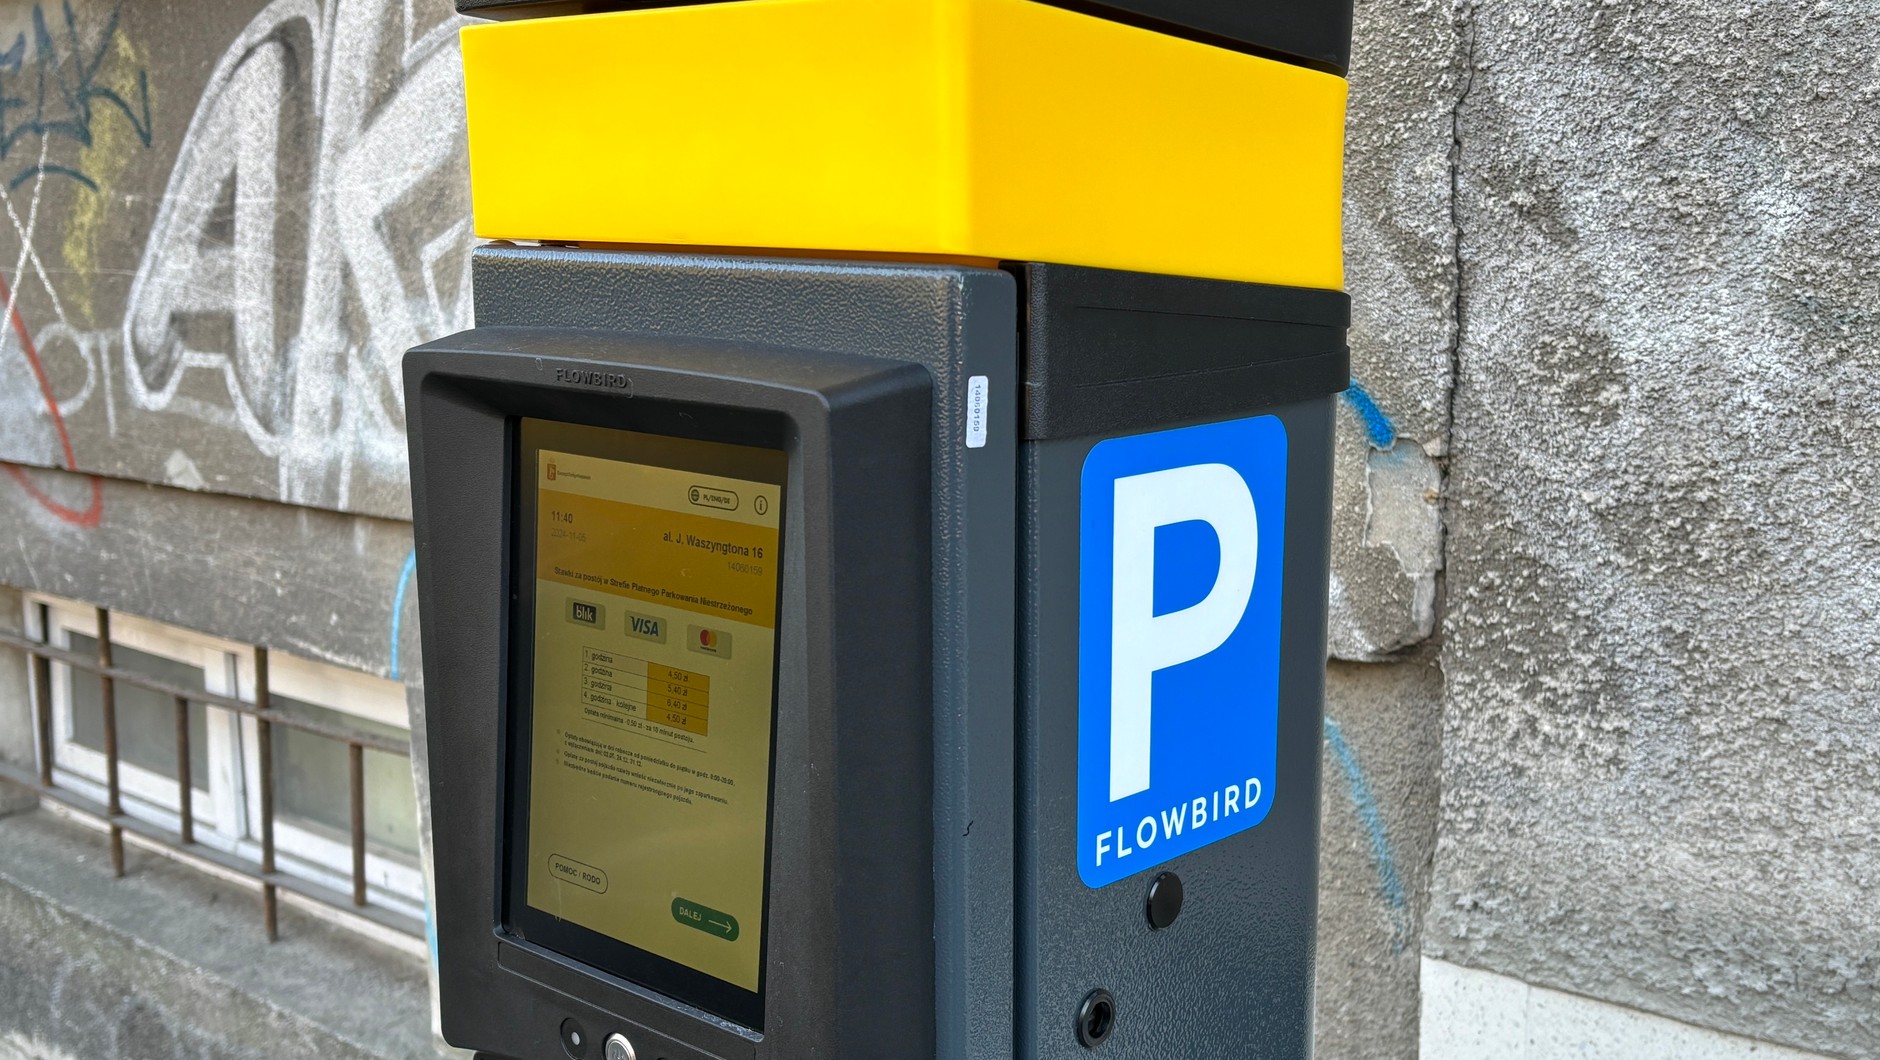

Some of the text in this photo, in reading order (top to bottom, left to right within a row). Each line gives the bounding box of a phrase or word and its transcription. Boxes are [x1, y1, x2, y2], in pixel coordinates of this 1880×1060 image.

[556, 368, 628, 389] FLOWBIRD
[551, 511, 573, 524] 11:40
[663, 531, 764, 559] al. J. Waszyngtona 16
[554, 566, 574, 577] Stawki
[574, 571, 582, 580] za
[603, 577, 608, 585] w
[661, 588, 699, 604] Parkowania
[699, 596, 753, 617] Niestrzeżonego
[575, 604, 593, 622] blik
[629, 615, 659, 637] VISA
[1110, 462, 1258, 802] P
[591, 651, 613, 664] godzina
[1096, 777, 1262, 867] FLOWBIRD
[555, 862, 578, 877] POMOC
[582, 872, 601, 885] RODO
[679, 906, 702, 922] DALEJ
